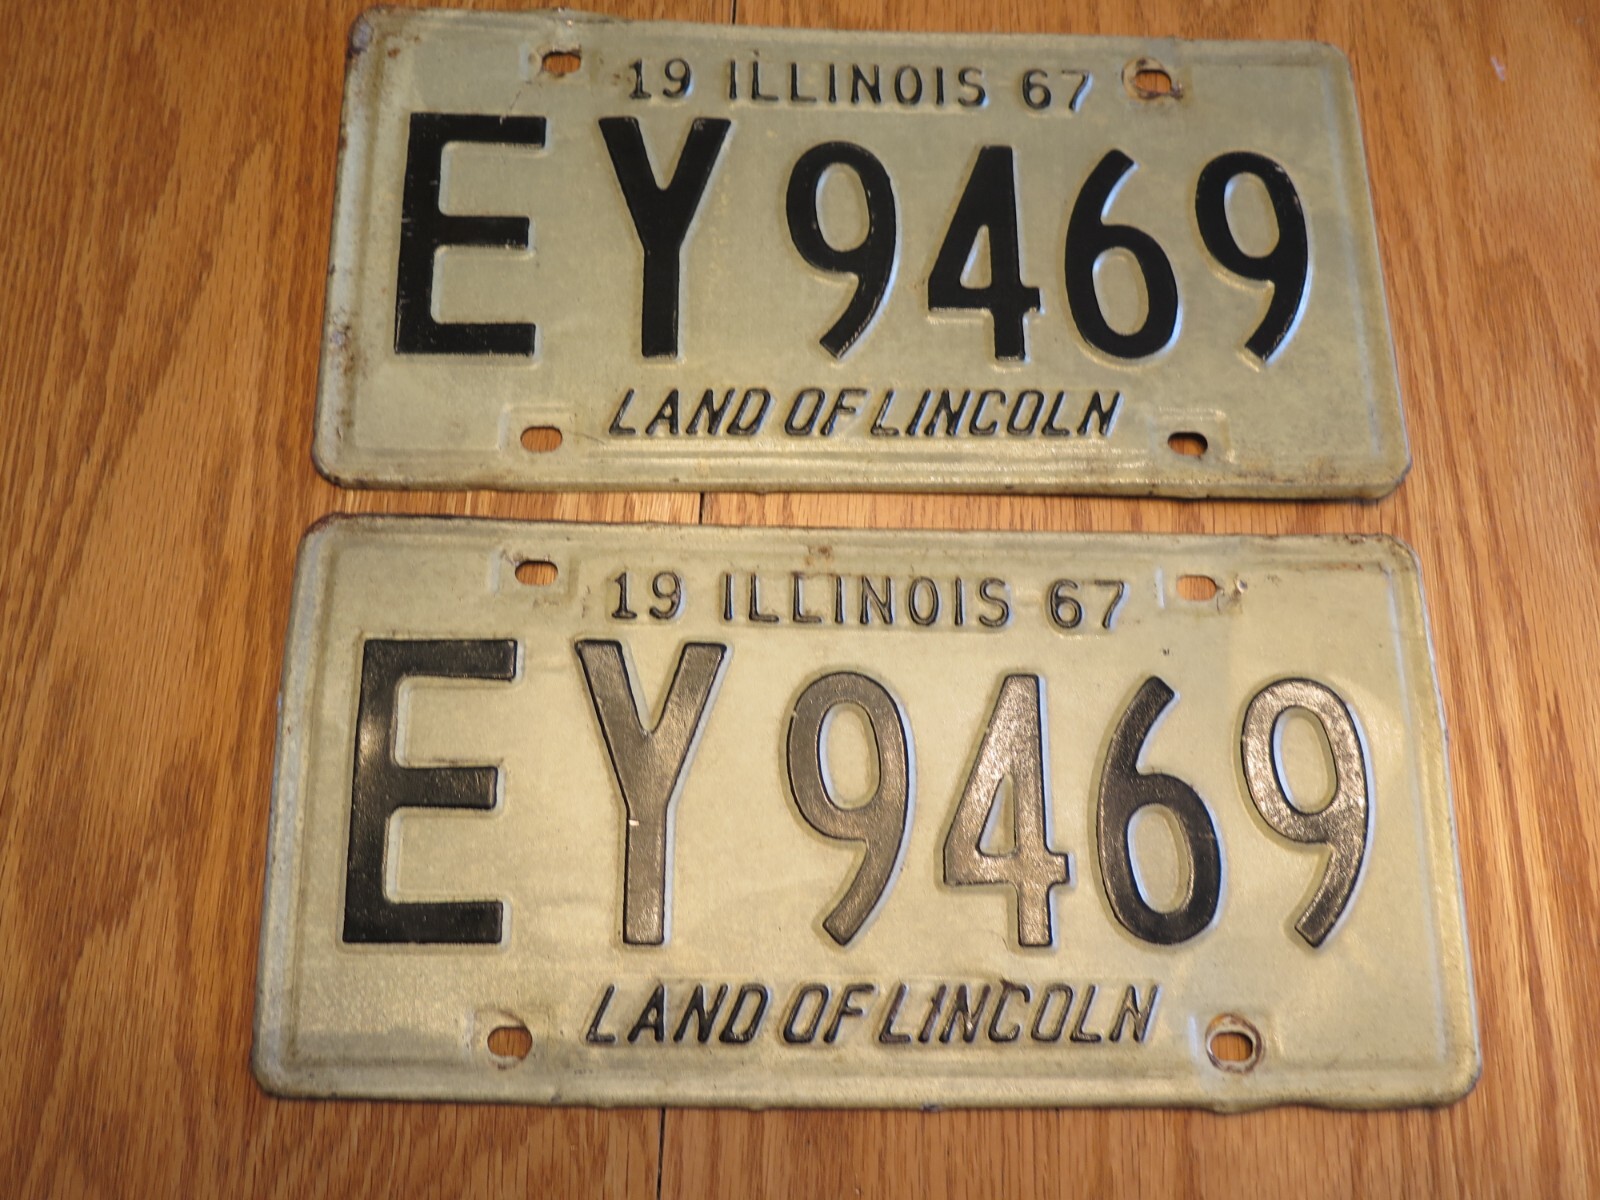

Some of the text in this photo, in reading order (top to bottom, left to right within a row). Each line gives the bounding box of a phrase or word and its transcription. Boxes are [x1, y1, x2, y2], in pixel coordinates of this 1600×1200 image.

[630, 59, 1093, 111] 19 ILLINOIS 67
[609, 388, 1121, 438] LAND OF LINCOLN
[612, 571, 1126, 629] 19 ILLINOIS 67
[587, 983, 1159, 1044] LAND OF LINCOLN
